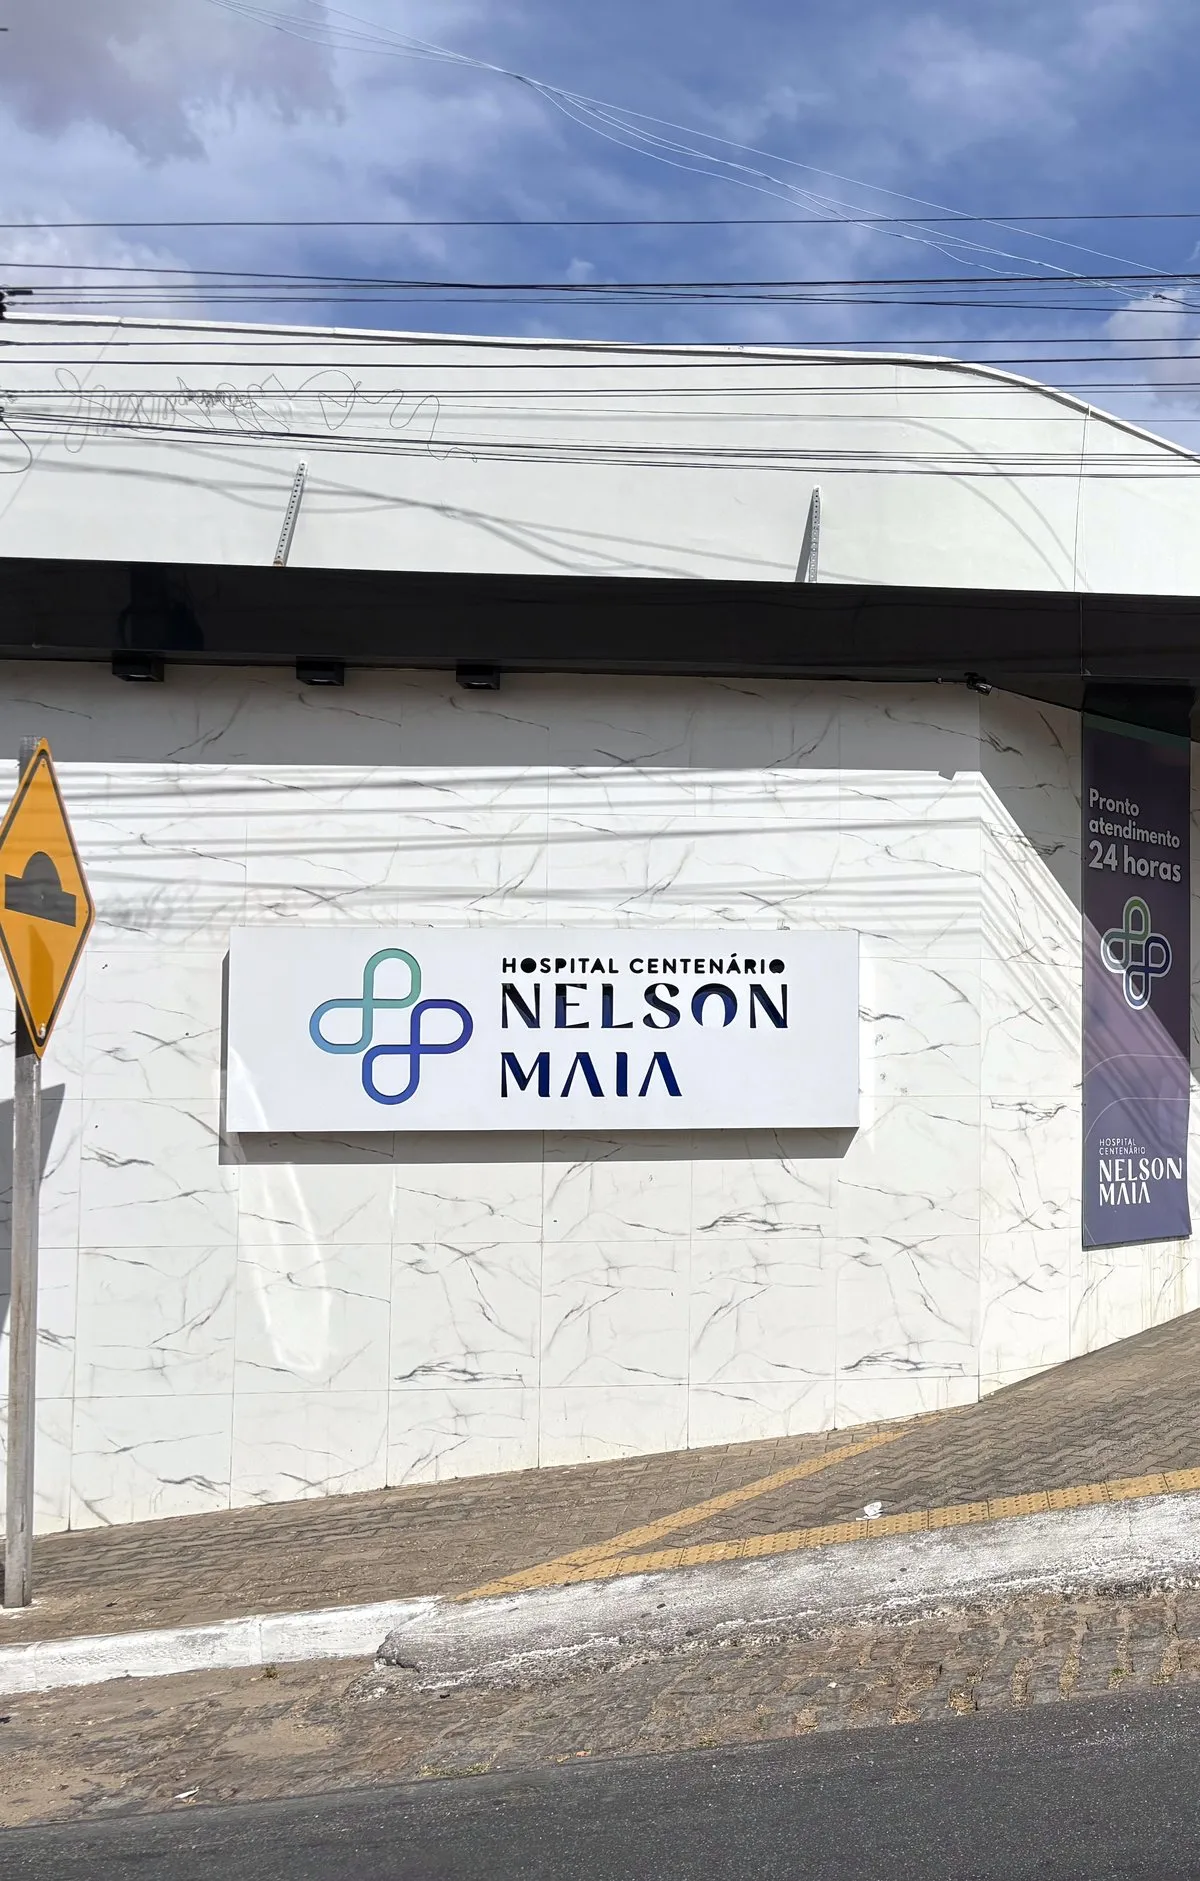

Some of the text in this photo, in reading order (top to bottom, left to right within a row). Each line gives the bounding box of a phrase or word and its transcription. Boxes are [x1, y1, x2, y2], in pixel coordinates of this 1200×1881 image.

[1089, 787, 1140, 817] Pronto
[1088, 816, 1180, 848] atendimento
[1088, 839, 1182, 882] 24 horas
[501, 952, 786, 975] HOSPITAL CENTENÁRIO
[500, 982, 789, 1030] NELSON
[499, 1051, 683, 1098] MAIA
[1099, 1138, 1137, 1147] HOSPITAL
[1099, 1145, 1146, 1156] CENTENÁRIO
[1099, 1157, 1183, 1182] NELSON
[1099, 1181, 1151, 1207] MAIA
